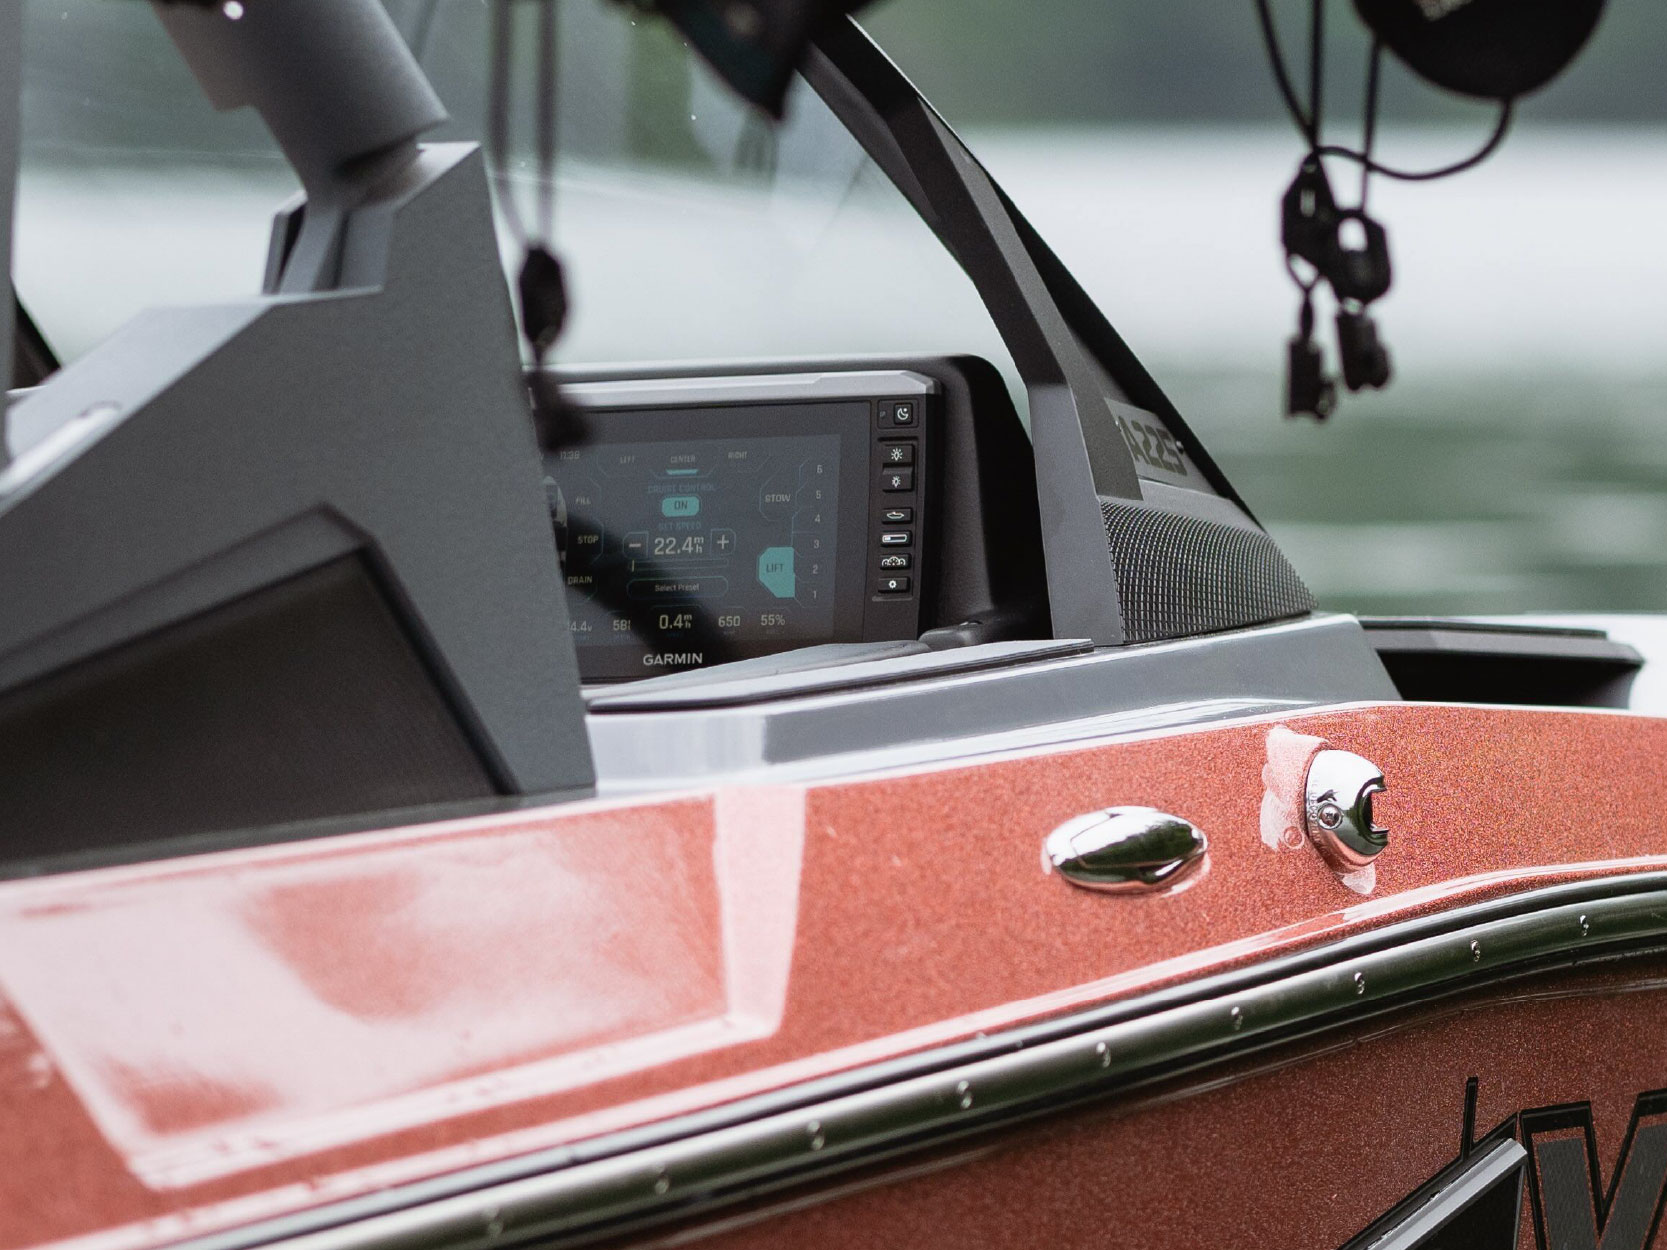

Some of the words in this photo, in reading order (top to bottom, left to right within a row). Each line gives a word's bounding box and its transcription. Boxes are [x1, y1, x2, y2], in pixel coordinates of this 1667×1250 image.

[670, 455, 696, 464] CENTER
[727, 451, 748, 460] RIGHT
[765, 494, 791, 503] STOW
[816, 490, 822, 500] 5
[674, 501, 688, 510] ON
[814, 514, 821, 523] 4
[577, 535, 599, 544] STOP
[654, 536, 693, 556] 22.4
[813, 540, 820, 549] 3
[766, 563, 784, 573] LIFT
[812, 565, 819, 574] 2
[567, 576, 593, 585] DRAIN
[655, 584, 676, 592] Select
[678, 583, 700, 592] Preset
[718, 615, 741, 628] 650
[760, 614, 786, 627] 55%
[643, 652, 703, 666] GARMIN
